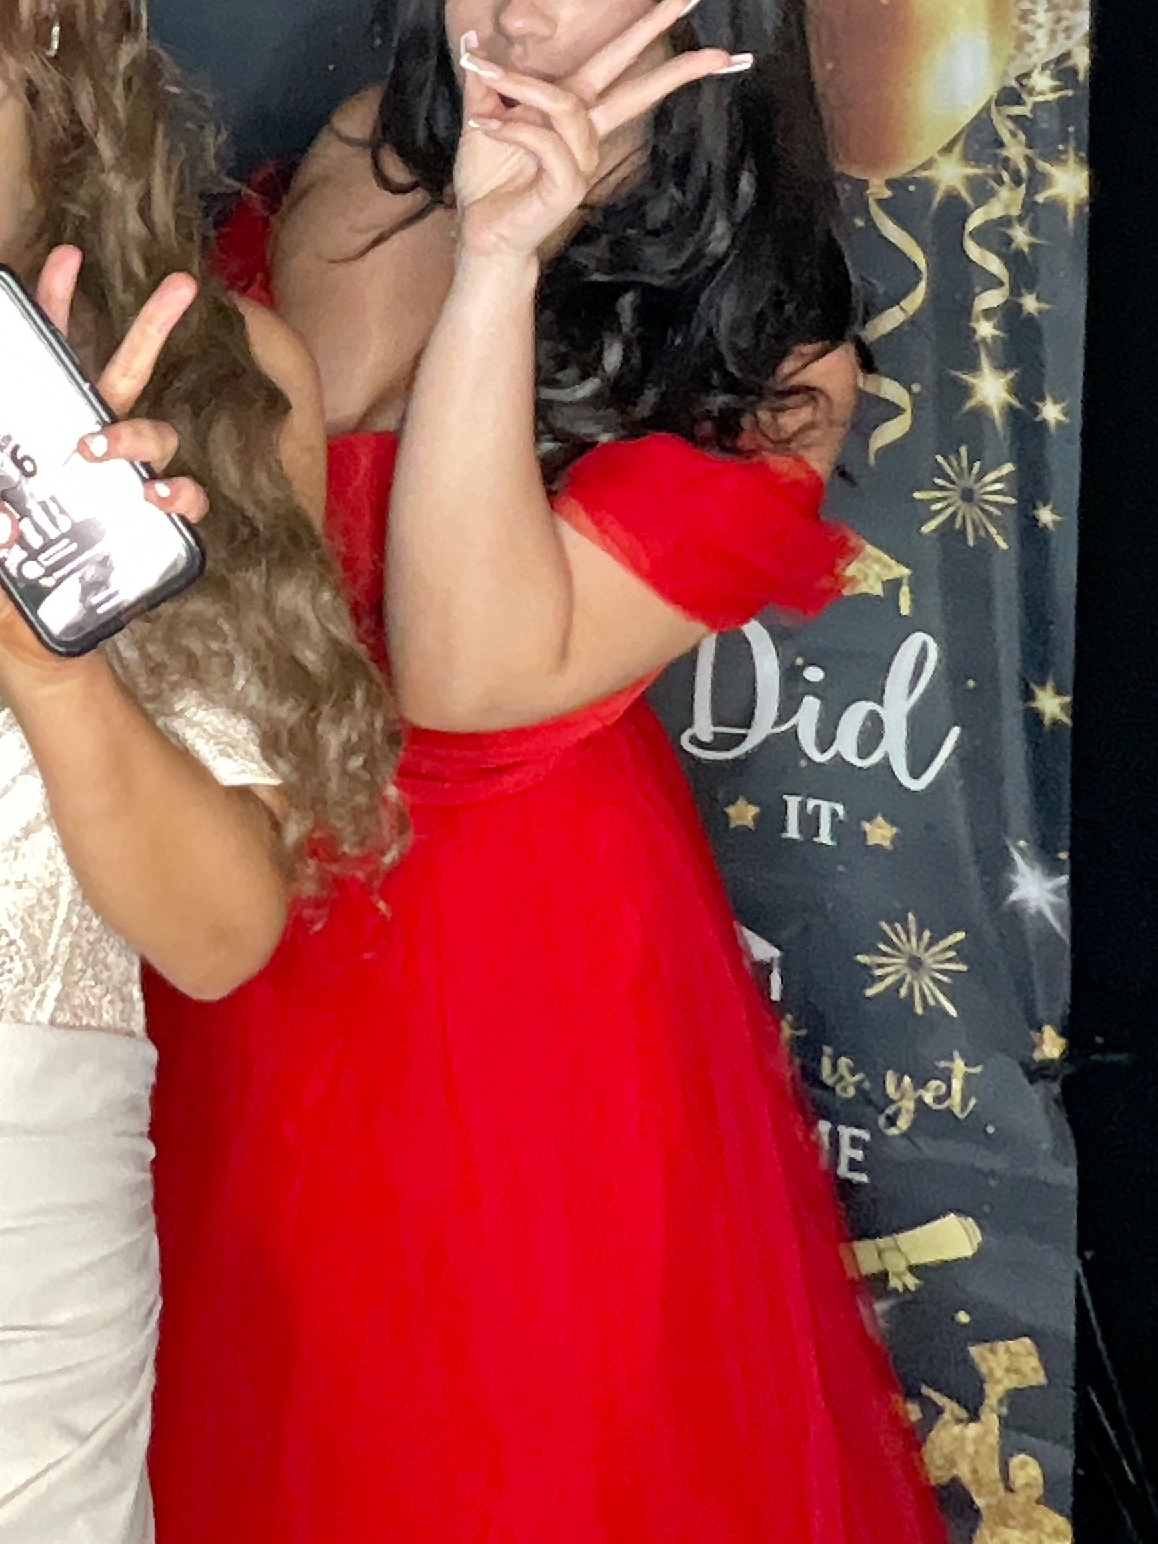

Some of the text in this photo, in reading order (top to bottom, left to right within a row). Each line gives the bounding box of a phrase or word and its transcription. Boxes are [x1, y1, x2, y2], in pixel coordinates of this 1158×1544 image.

[680, 618, 962, 791] Did
[780, 793, 846, 847] IT
[877, 1049, 985, 1136] yet
